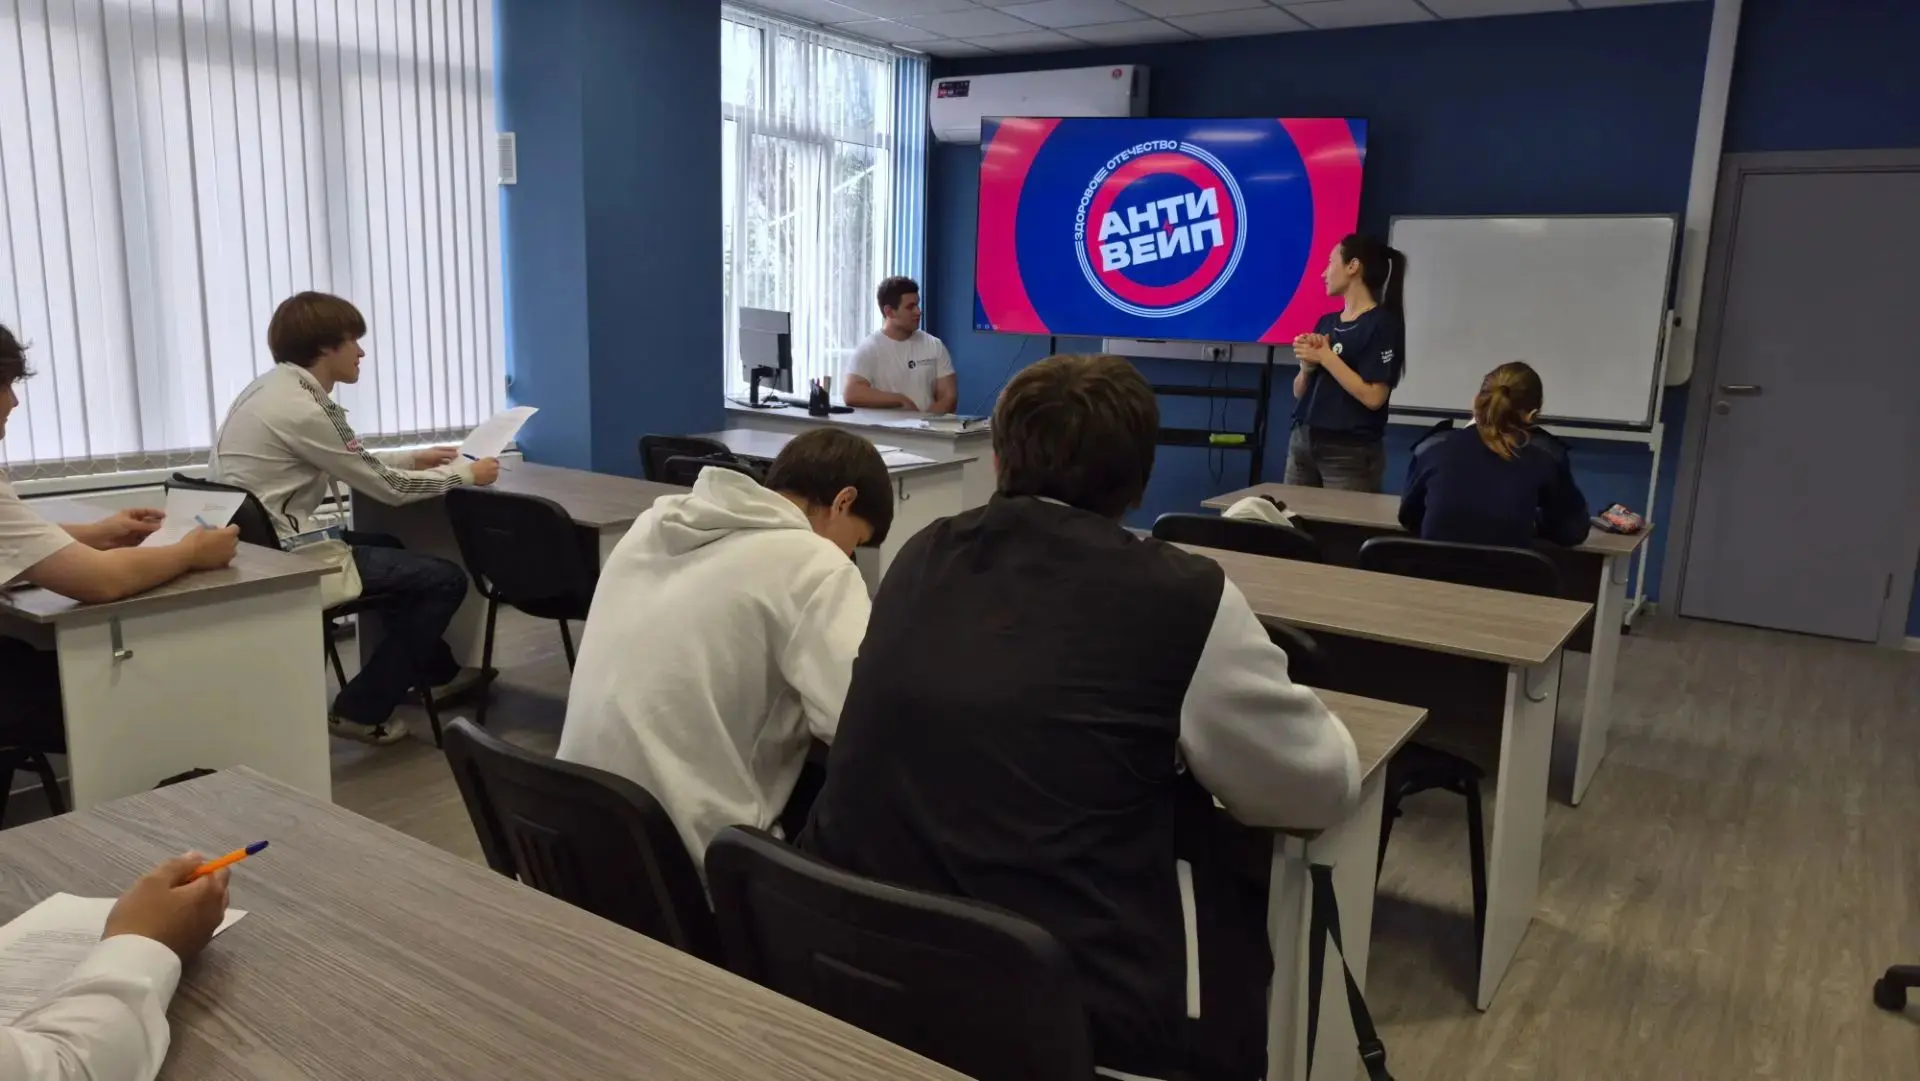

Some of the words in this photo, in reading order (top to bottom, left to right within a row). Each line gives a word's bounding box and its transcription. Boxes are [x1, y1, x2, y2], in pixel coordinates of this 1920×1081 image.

[1074, 167, 1109, 240] ЗДОРОВОЕ
[1107, 140, 1178, 170] ОТЕЧЕСТВО
[1098, 187, 1219, 241] АНТИ
